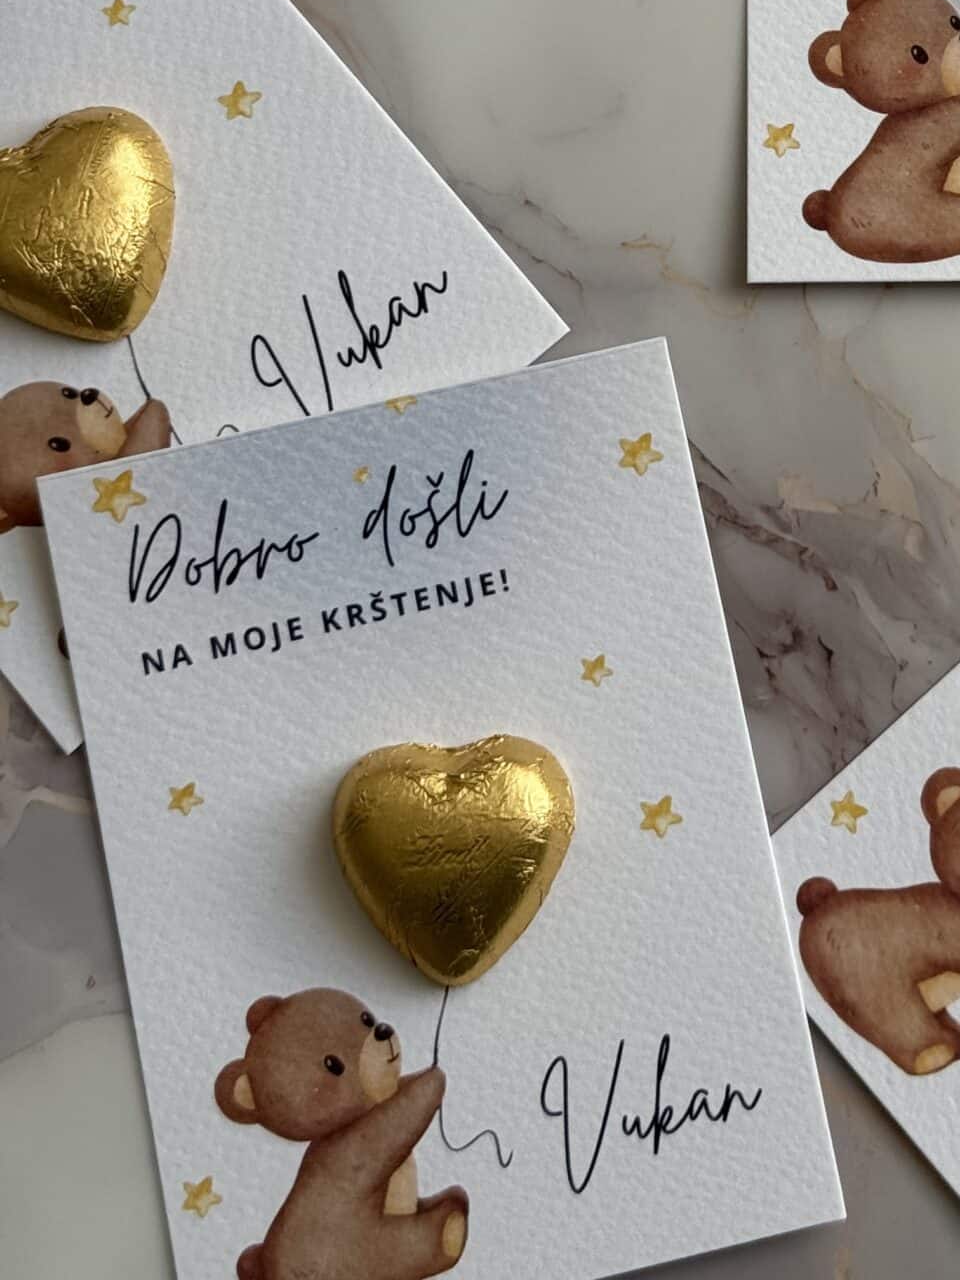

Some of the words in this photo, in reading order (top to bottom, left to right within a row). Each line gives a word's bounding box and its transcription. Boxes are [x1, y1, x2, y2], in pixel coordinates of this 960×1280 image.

[250, 269, 449, 417] Vukan
[127, 498, 320, 604] Dobro
[363, 448, 510, 568] došli
[140, 643, 194, 677] NA
[208, 616, 305, 660] MOJE
[320, 568, 510, 634] KRŠTENJE!
[539, 1033, 763, 1196] Vukan
